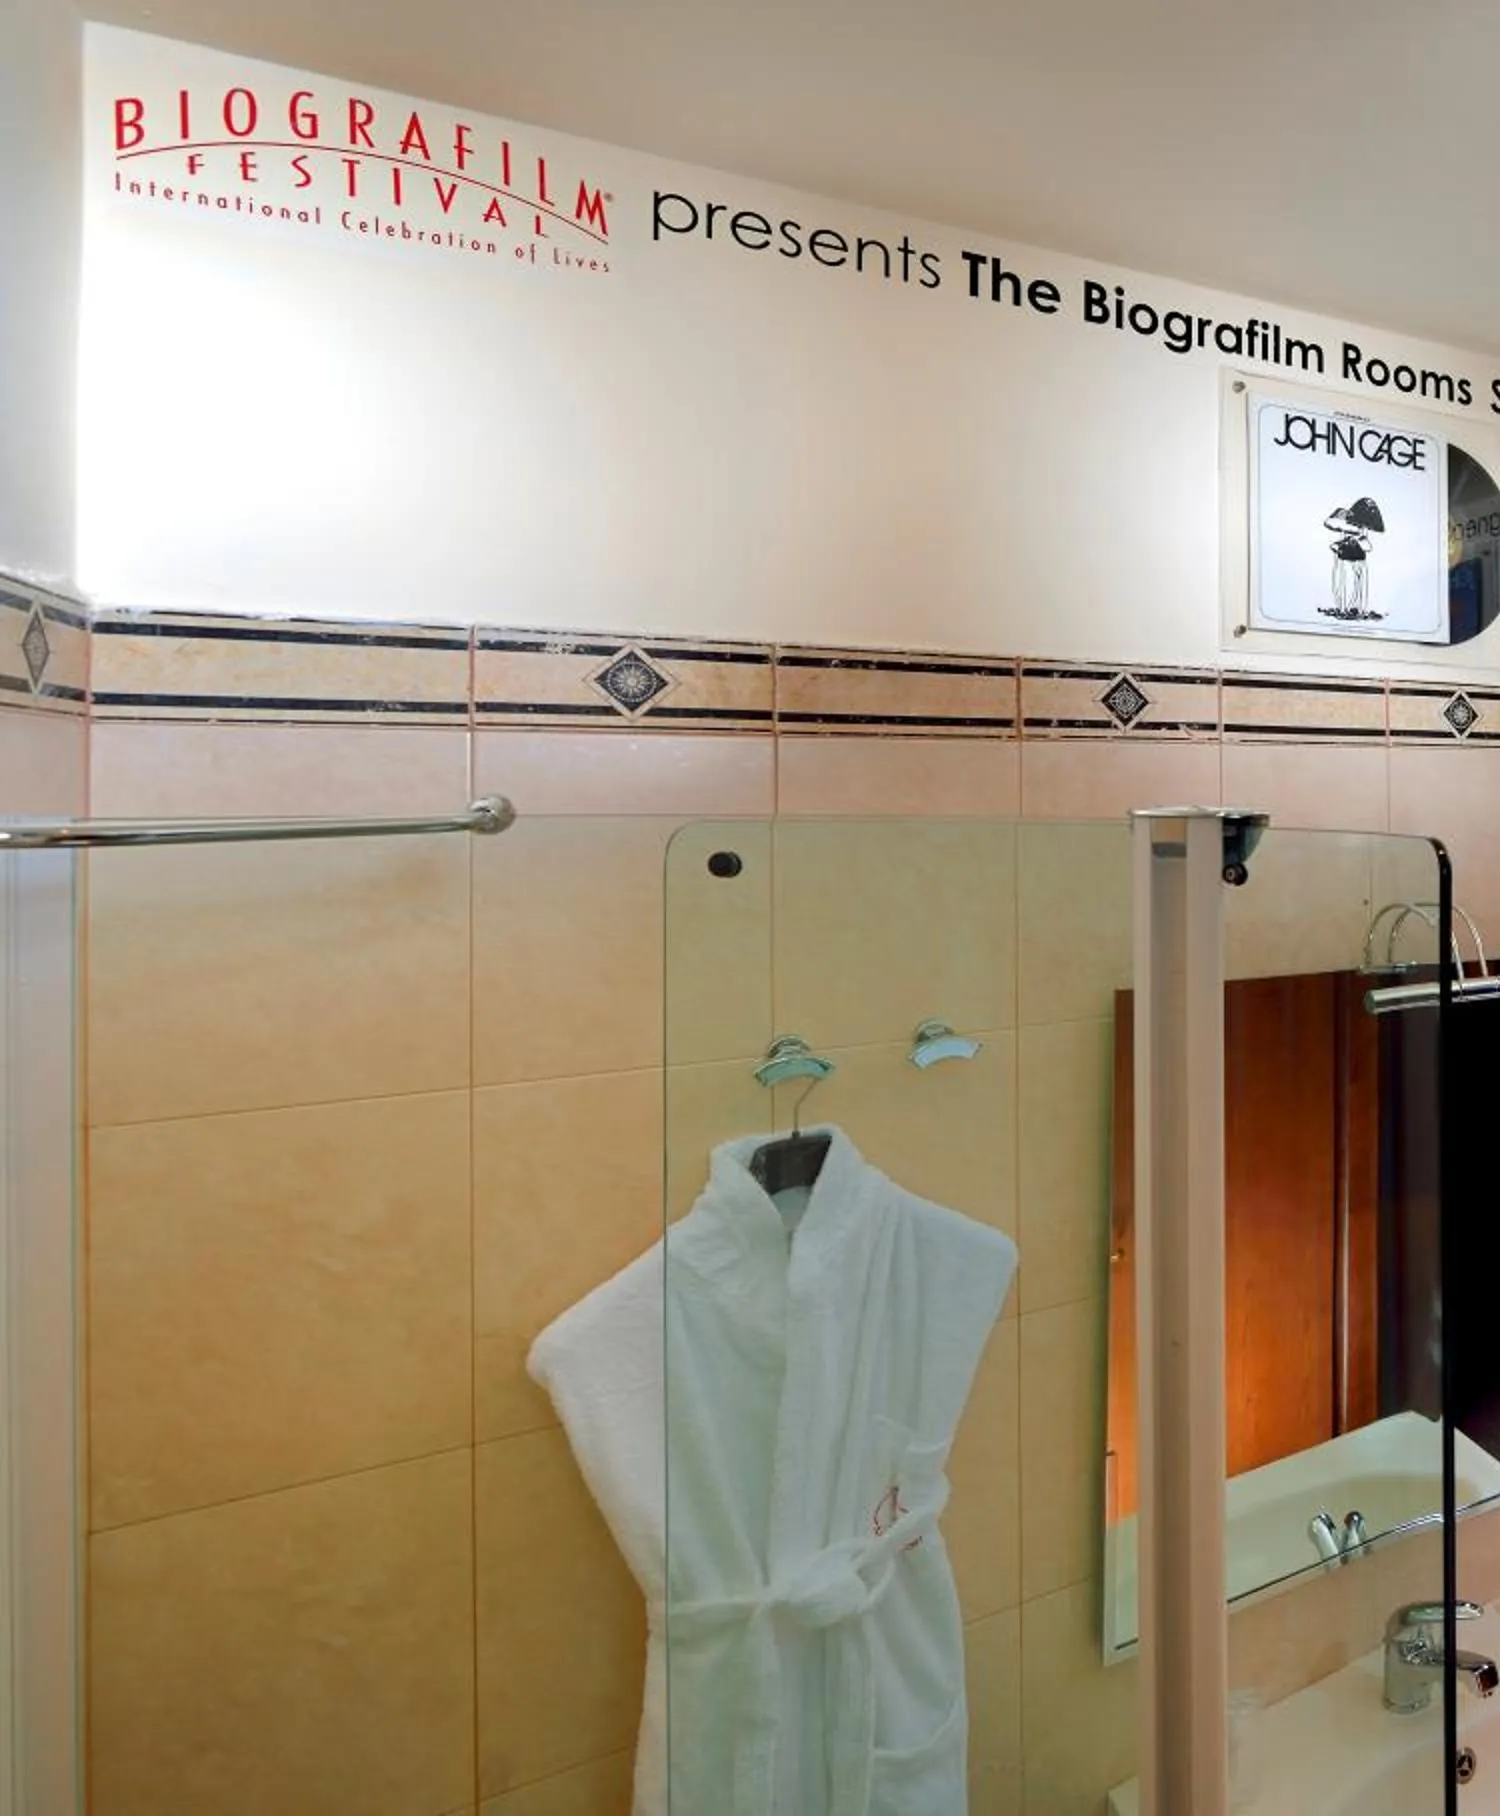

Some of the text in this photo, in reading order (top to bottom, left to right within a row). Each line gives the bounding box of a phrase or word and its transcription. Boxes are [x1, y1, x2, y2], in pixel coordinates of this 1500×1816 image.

[115, 87, 610, 237] BIOGRAFILM
[187, 151, 548, 238] FESTIVAL
[115, 172, 321, 226] International
[341, 211, 497, 255] Celebration
[514, 242, 537, 266] of
[652, 189, 941, 289] presents
[961, 250, 1061, 314] The
[1083, 279, 1324, 374] Biografilm
[1343, 342, 1473, 406] Rooms
[1273, 413, 1426, 472] JOHN CAGE
